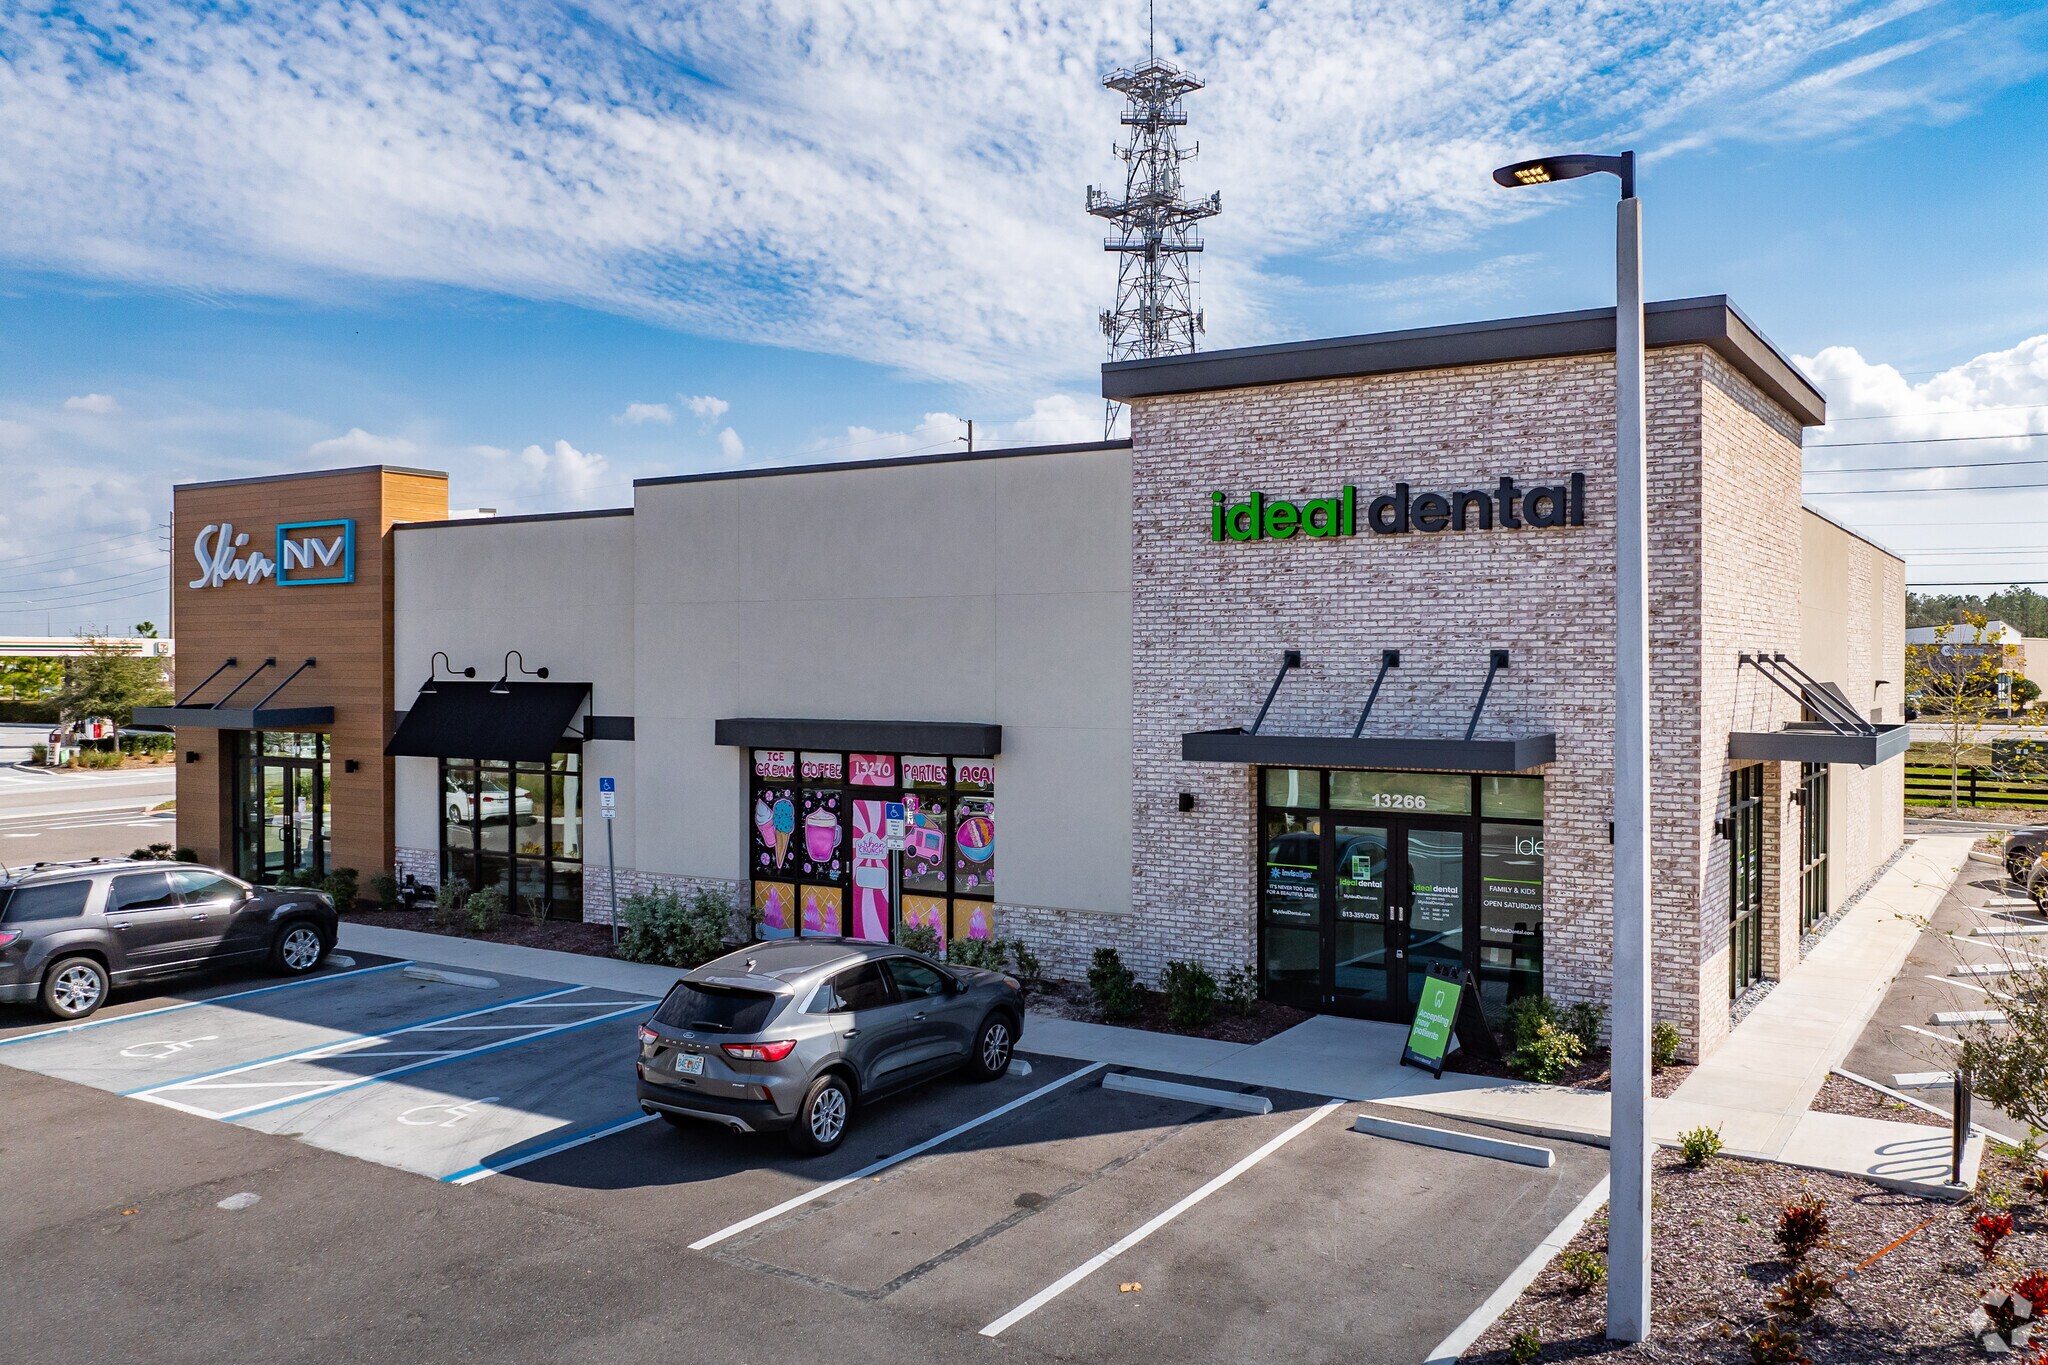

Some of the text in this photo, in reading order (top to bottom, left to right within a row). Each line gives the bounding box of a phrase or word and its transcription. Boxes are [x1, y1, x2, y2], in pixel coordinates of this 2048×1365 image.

[1211, 473, 1585, 542] ideal dental
[189, 523, 345, 589] Skin NV
[767, 752, 785, 761] ICE
[755, 763, 795, 778] CREAM
[801, 762, 842, 779] COFFEE
[855, 761, 891, 777] 13270
[903, 764, 947, 783] PARTIES
[1371, 793, 1426, 809] 13266
[1340, 878, 1382, 888] ideal dental
[1433, 885, 1458, 893] dental
[1489, 885, 1513, 894] FAMILY
[1520, 888, 1536, 896] KIDS
[1483, 900, 1542, 911] OPEN SATURDAYS
[1416, 1019, 1430, 1028] new
[1419, 1009, 1450, 1028] Accepting
[1413, 1027, 1439, 1040] patients
